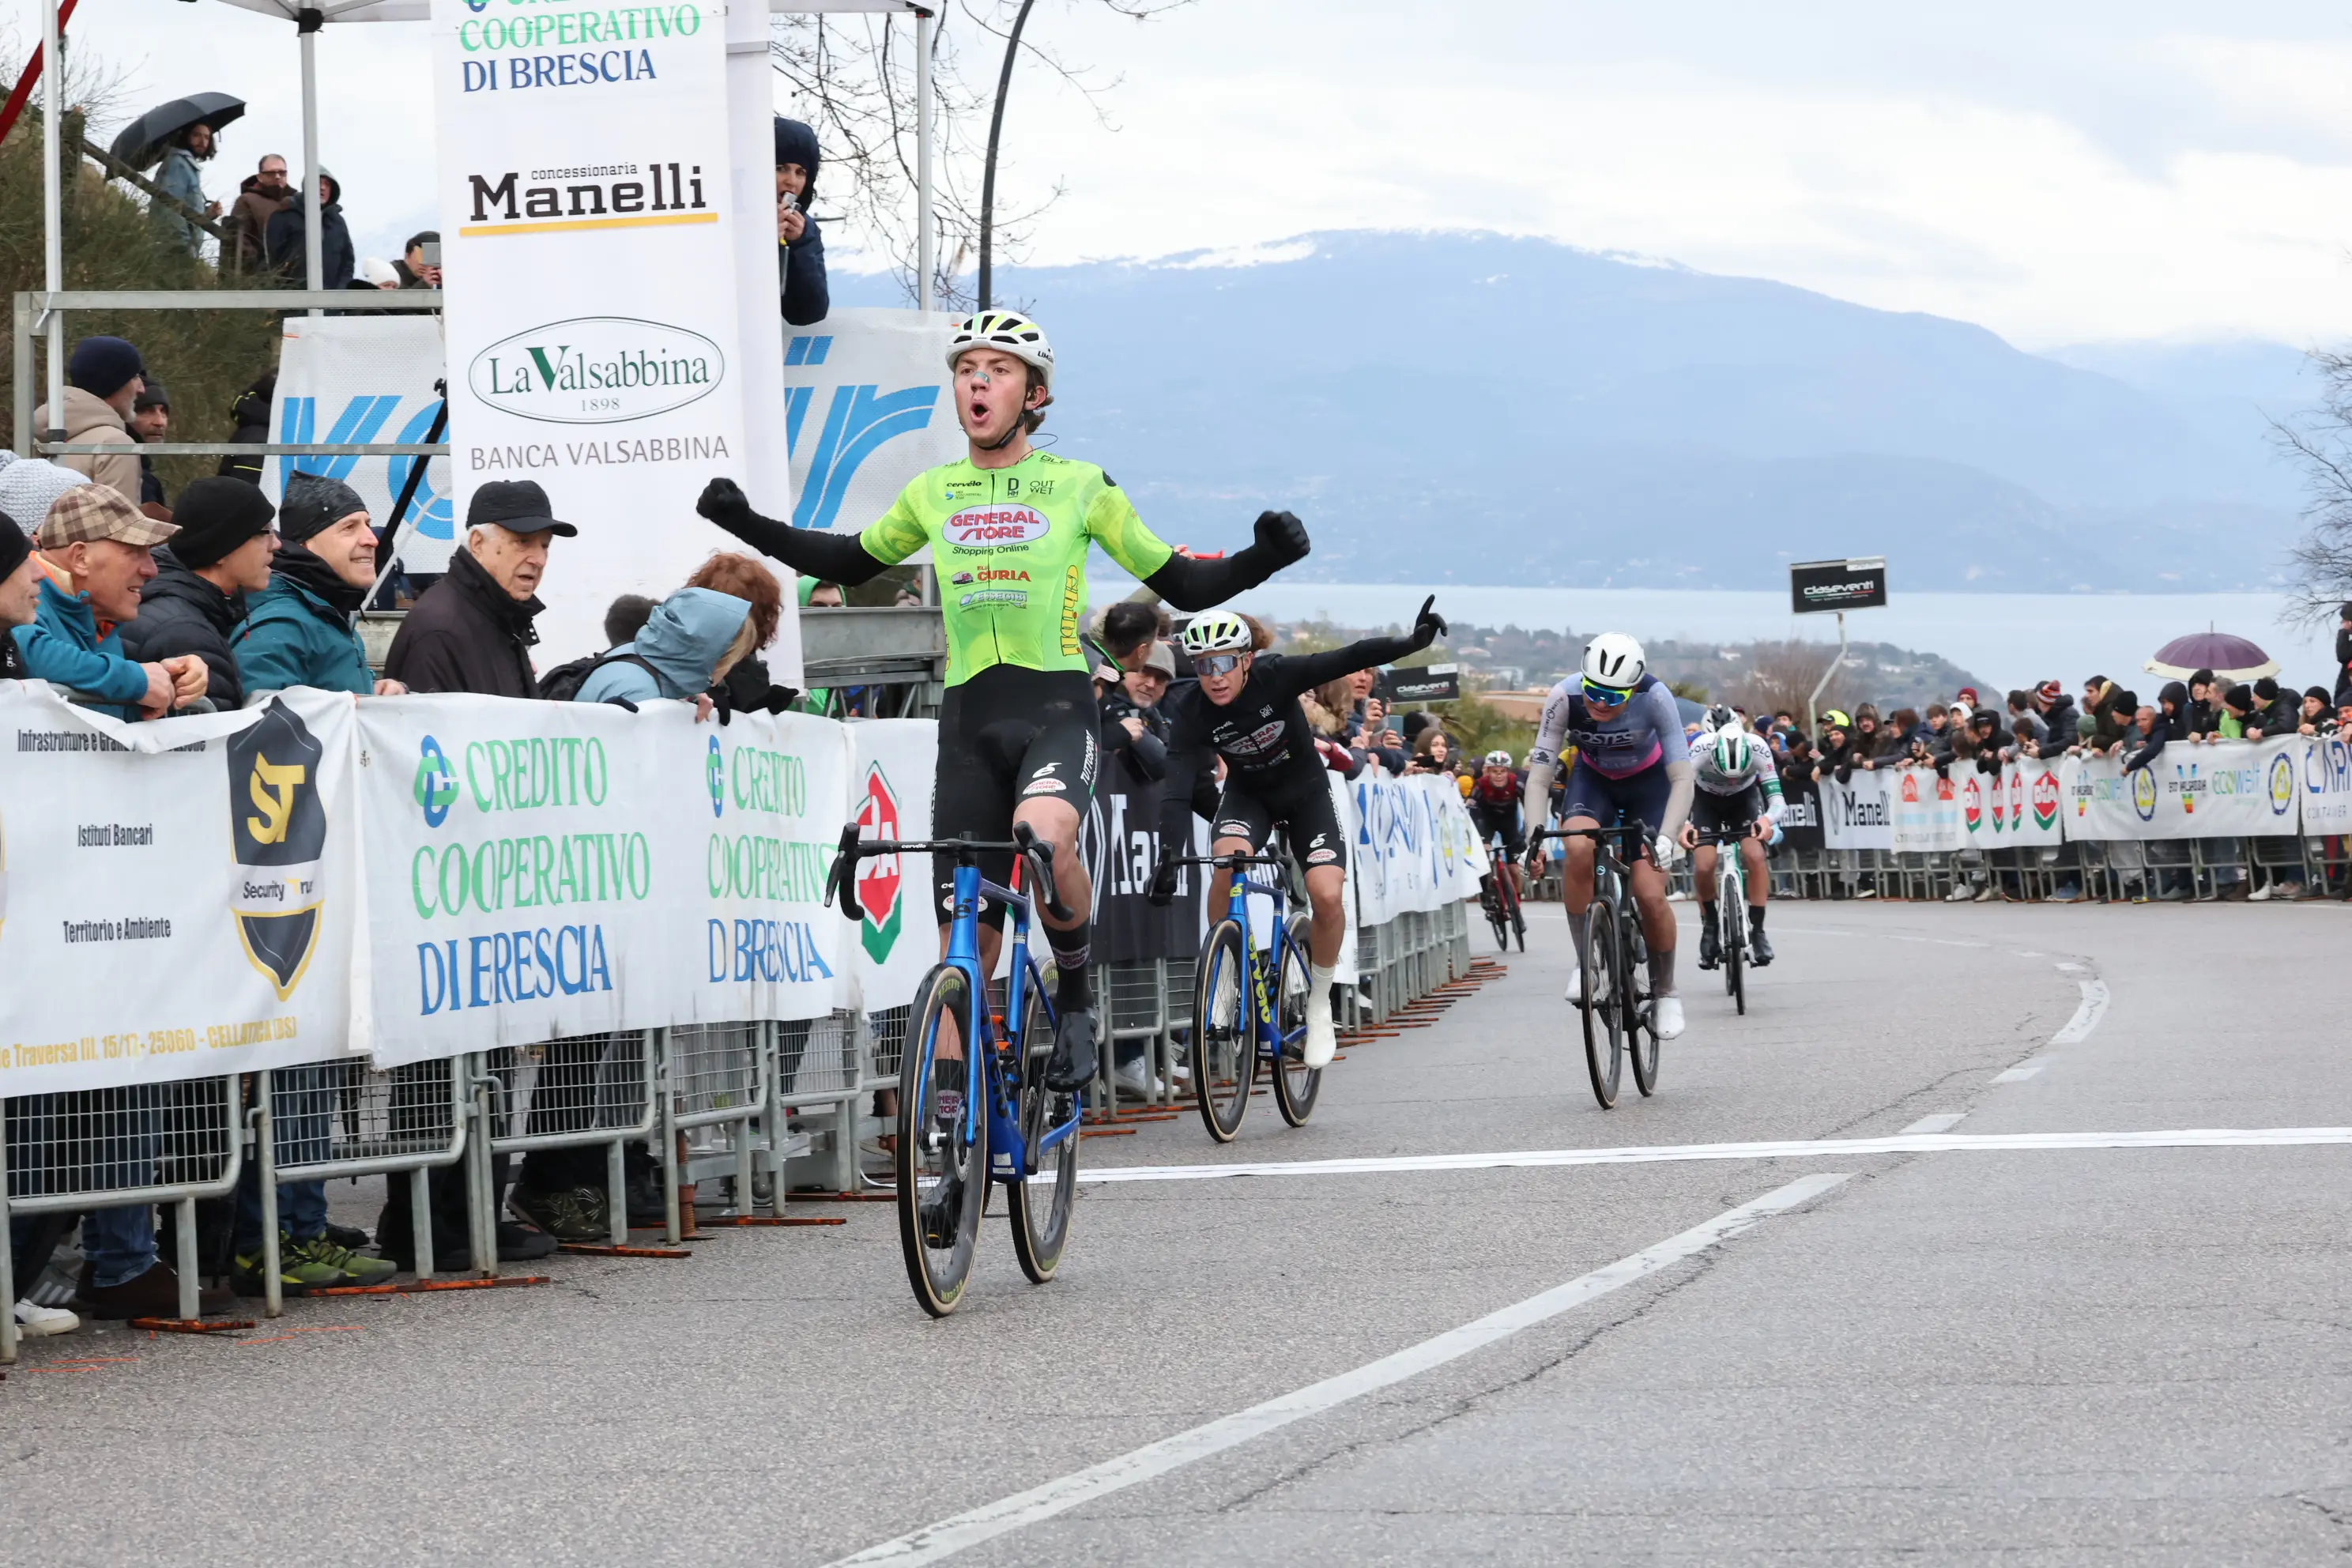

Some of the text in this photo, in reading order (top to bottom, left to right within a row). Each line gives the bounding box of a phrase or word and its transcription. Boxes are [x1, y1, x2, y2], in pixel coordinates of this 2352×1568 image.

[460, 4, 701, 51] COOPERATIVO
[462, 49, 658, 92] DI BRESCIA
[531, 162, 638, 180] concessionaria
[468, 162, 707, 221] Manelli
[526, 345, 710, 392] Valsabbina
[581, 398, 620, 412] 1898
[470, 435, 729, 470] BANCA VALSABBINA
[1030, 487, 1054, 496] WET
[950, 511, 1040, 527] GENERAL
[959, 526, 1025, 541] STORE
[952, 545, 1029, 556] Shopping Online
[977, 570, 1031, 582] CURIA
[1080, 729, 1095, 786] TUTTOSPORT
[1752, 744, 1771, 758] OLO
[466, 737, 607, 813] CREDITO
[77, 824, 153, 847] Istituti Bancari
[412, 831, 650, 919] COOPERATIVO
[243, 880, 285, 902] Security
[63, 917, 171, 943] Territorio e Ambiente
[733, 918, 834, 982] BRESCIA
[417, 939, 461, 1016] DI
[13, 1042, 77, 1067] Traversa
[149, 1028, 196, 1055] 25060
